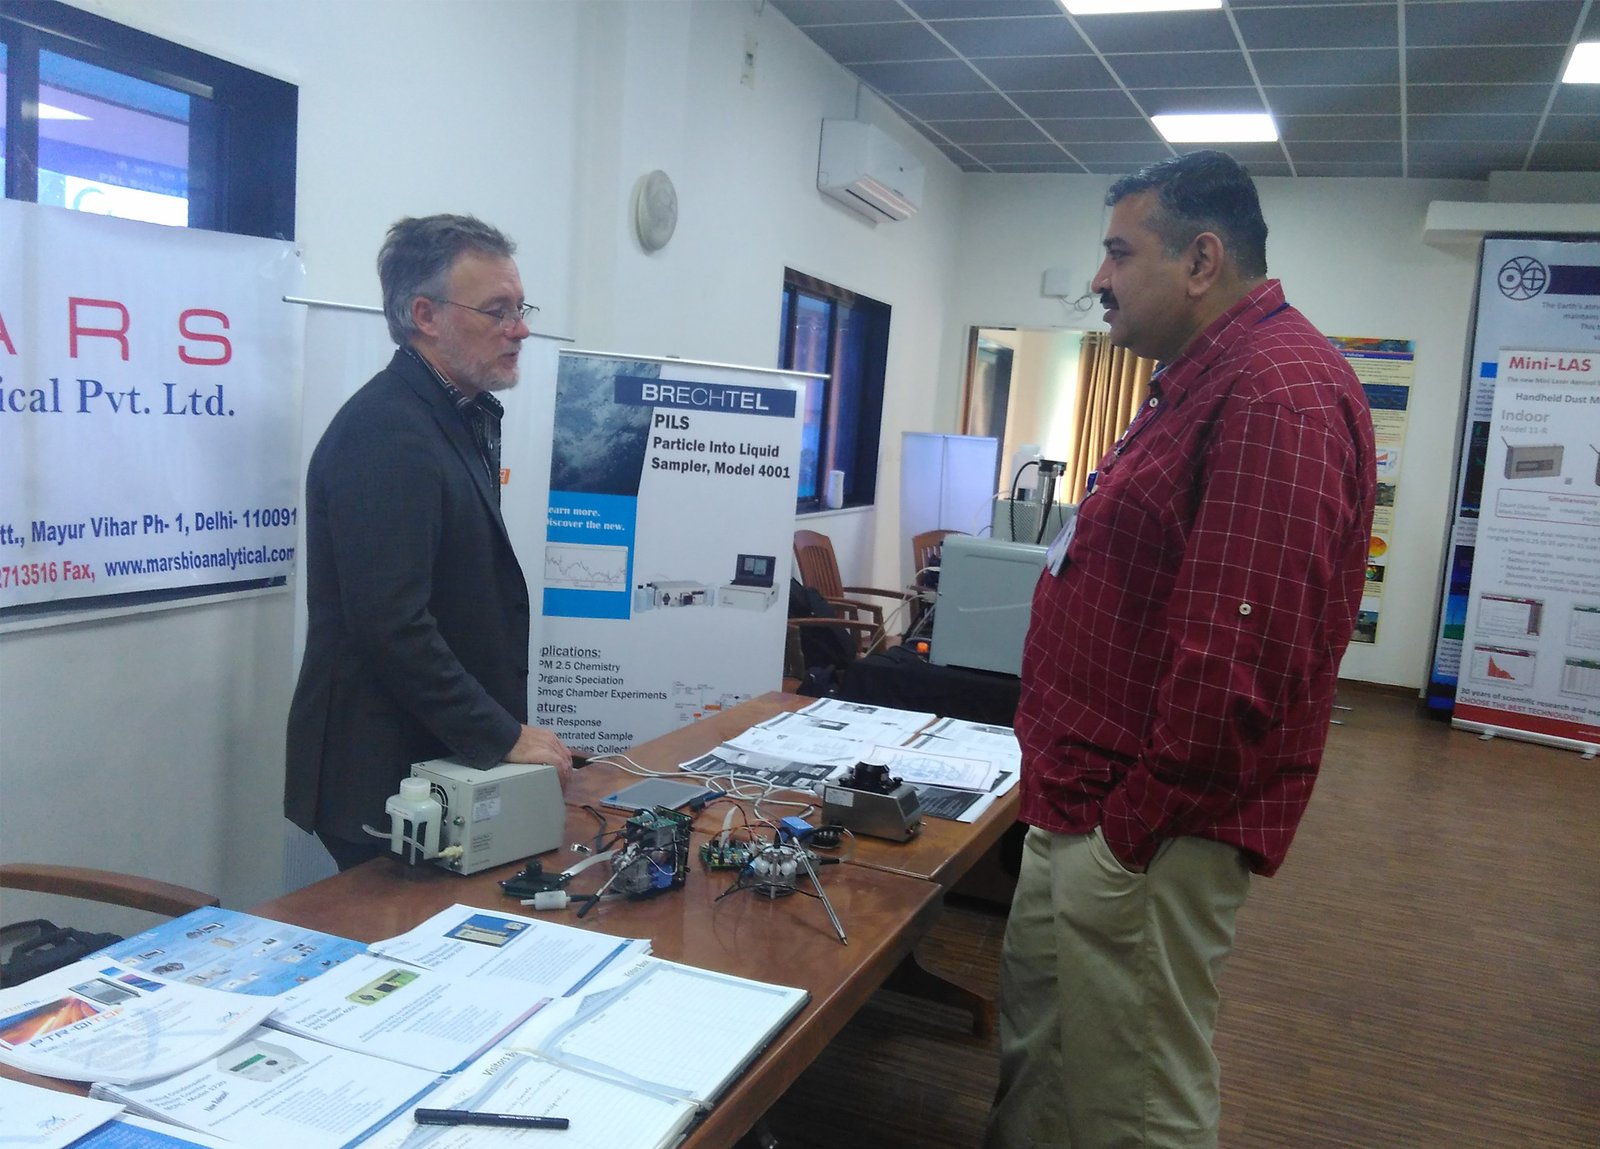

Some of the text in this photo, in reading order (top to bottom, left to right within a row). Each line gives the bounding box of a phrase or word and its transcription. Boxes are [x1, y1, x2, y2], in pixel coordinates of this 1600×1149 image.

[1509, 356, 1592, 372] Mini-LAS
[76, 379, 150, 415] Pvt.
[162, 382, 235, 416] Ltd.
[641, 383, 769, 411] BRECHTEL
[1516, 392, 1562, 402] Handheld
[1564, 395, 1587, 403] Dust
[654, 413, 690, 430] PILS
[1501, 409, 1550, 422] Indoor
[653, 436, 779, 459] Particle Into Liquid
[651, 456, 790, 479] Sampler, Model 4001
[573, 508, 600, 517] more.
[32, 520, 86, 546] Mayur
[90, 517, 138, 537] Vihar
[143, 514, 170, 535] Ph-
[175, 512, 190, 536] 1,
[195, 510, 238, 531] Delhi-
[242, 507, 297, 528] 110091
[547, 518, 625, 531] iscover the new.
[63, 560, 96, 583] Fax,
[104, 545, 295, 577] www.marsbioanalytical.com
[540, 645, 601, 659] plications:
[555, 660, 571, 670] 2.5
[573, 661, 620, 673] Chemistry
[575, 674, 624, 686] Speciation
[537, 686, 667, 700] Smog Chamber Experiments
[556, 717, 602, 728] Response
[554, 731, 633, 742] entrated Sample
